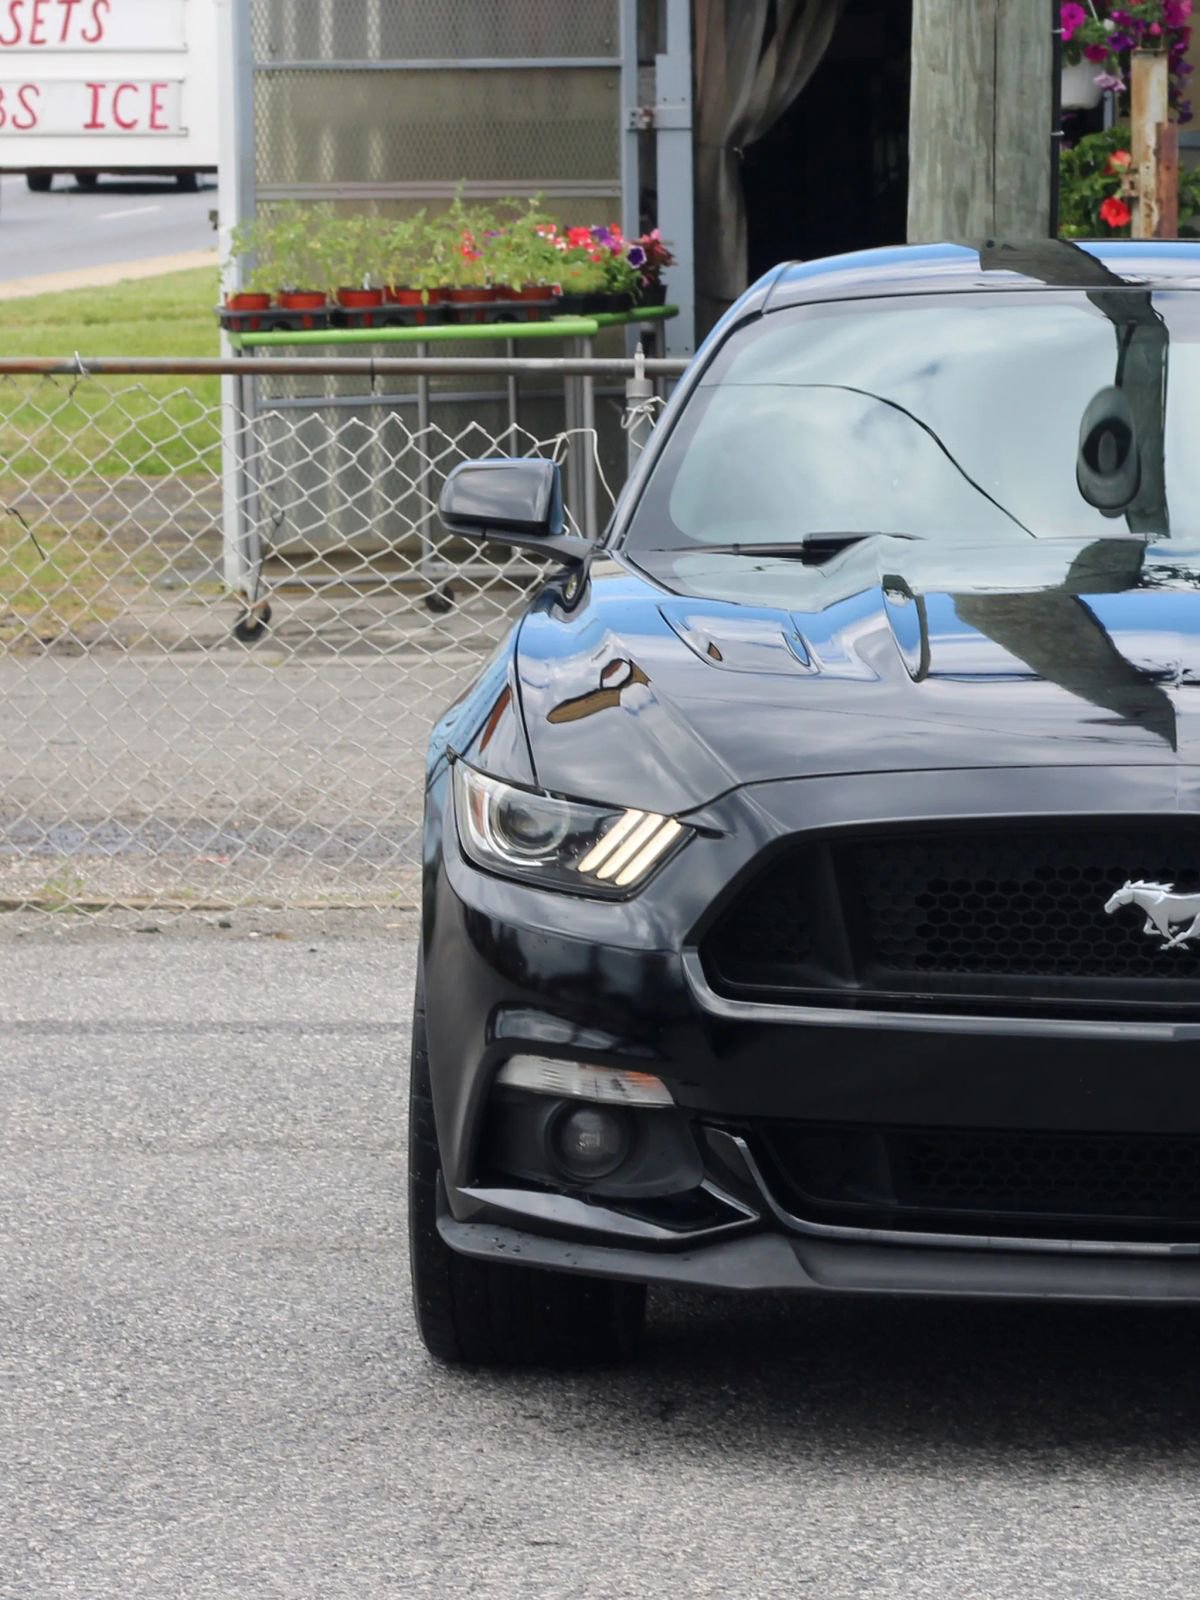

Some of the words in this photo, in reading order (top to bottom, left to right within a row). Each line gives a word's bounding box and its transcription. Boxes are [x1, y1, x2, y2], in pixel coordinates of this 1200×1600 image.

[0, 0, 110, 46] SETS
[0, 83, 40, 130] S
[83, 83, 169, 130] ICE
